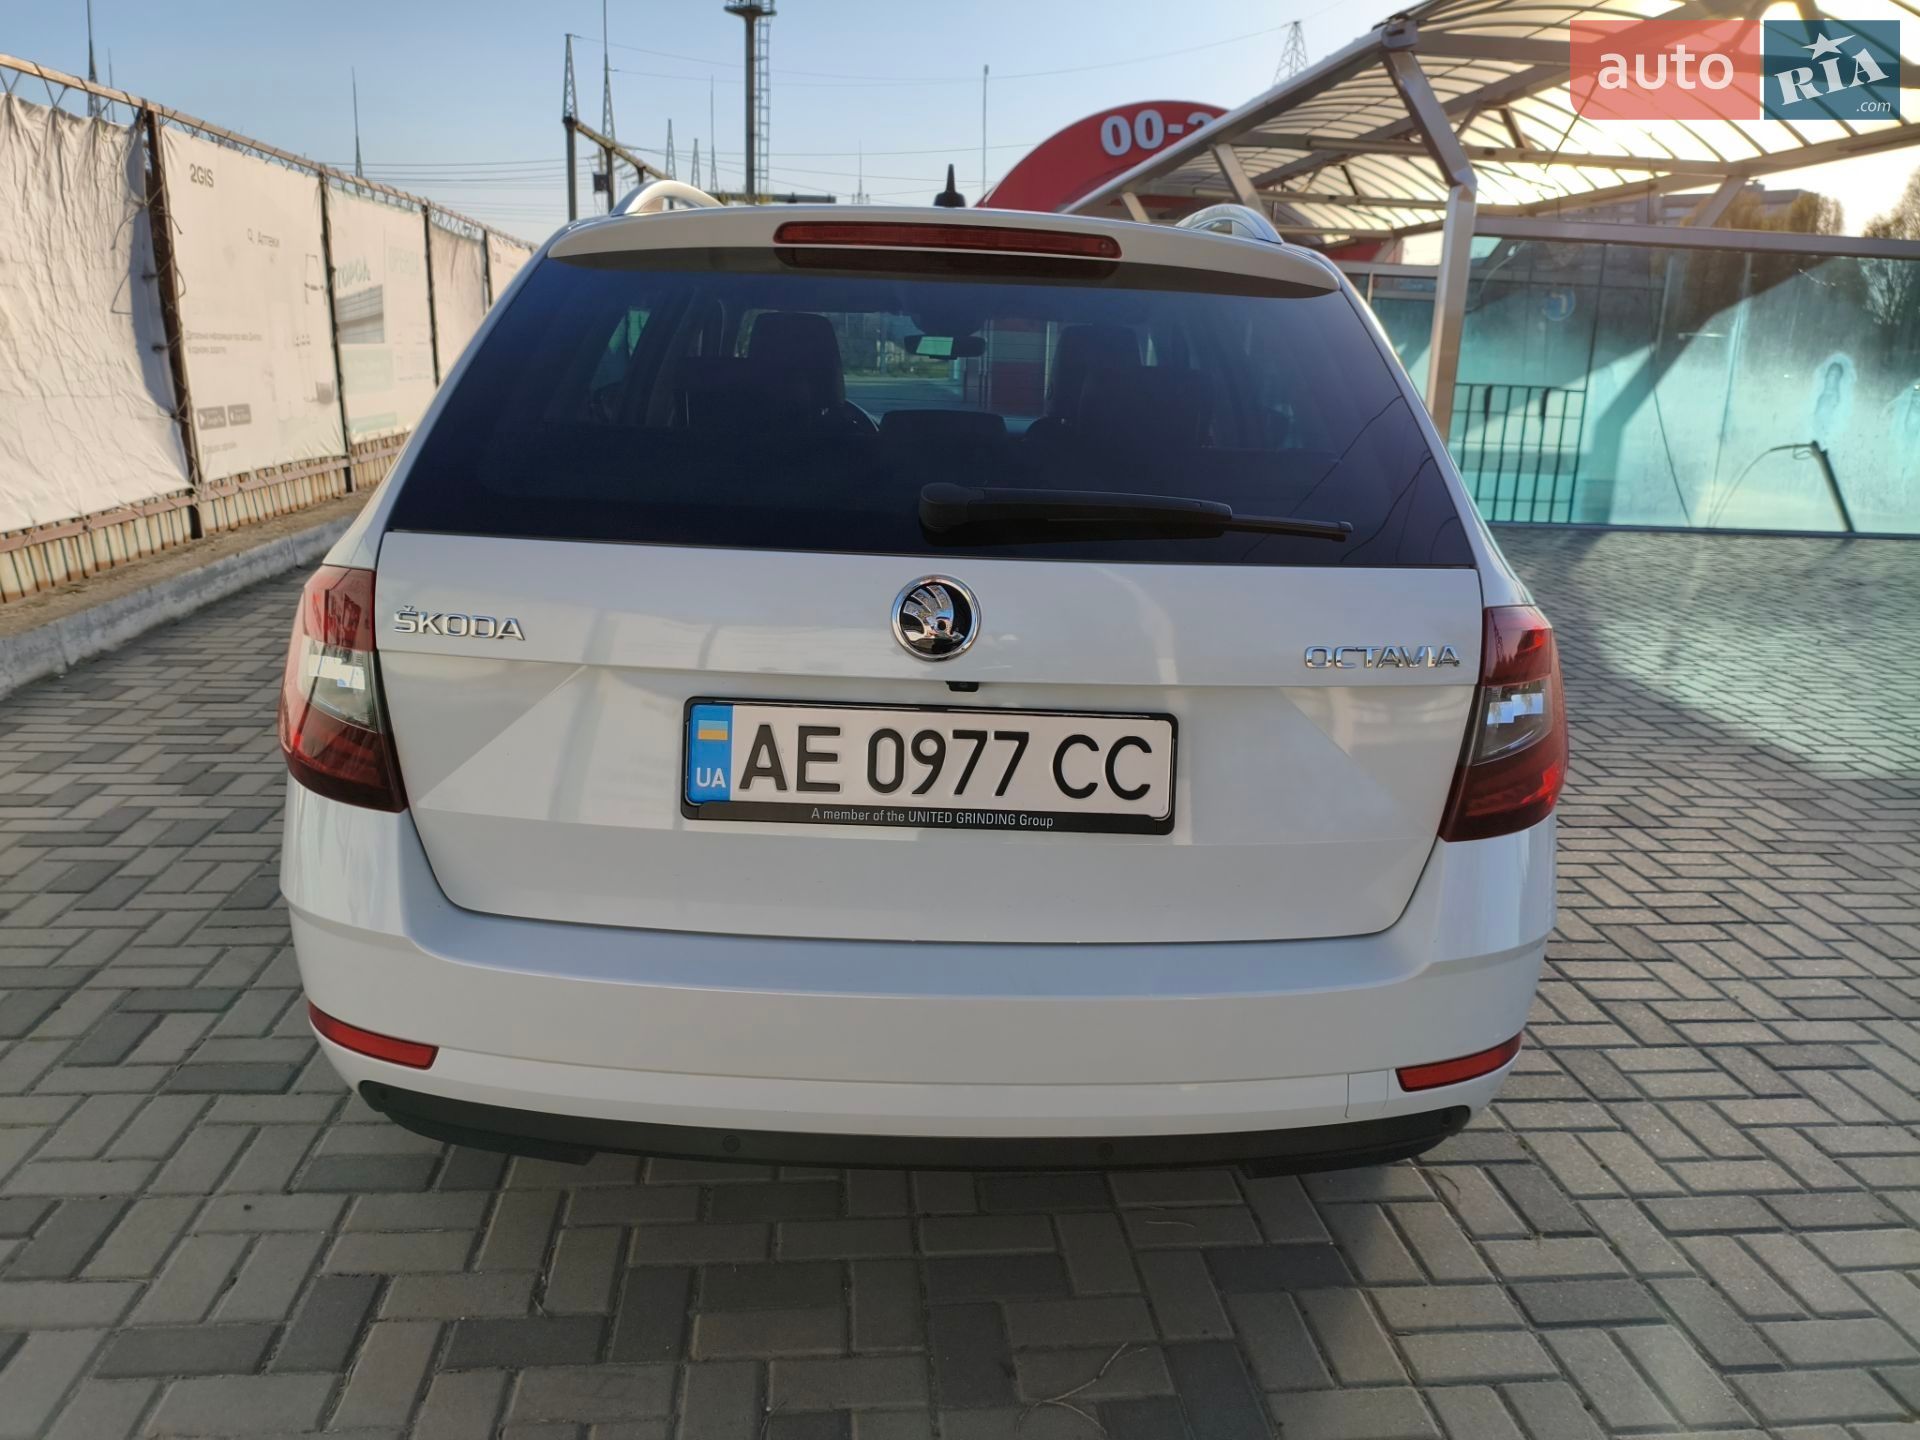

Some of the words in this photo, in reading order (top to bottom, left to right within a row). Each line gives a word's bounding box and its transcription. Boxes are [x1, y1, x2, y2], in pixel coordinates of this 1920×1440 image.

[190, 163, 214, 188] 2GIS
[393, 604, 526, 641] ŠKODA
[1304, 644, 1461, 669] OCTAVIA
[738, 723, 842, 793] AE
[866, 727, 1031, 798] 0977
[1051, 733, 1154, 801] CC
[695, 766, 727, 789] UA
[811, 807, 821, 819] A
[823, 808, 871, 821] member
[873, 809, 885, 821] of
[887, 810, 905, 822] the
[908, 810, 953, 824] UNITED
[956, 812, 1016, 826] GRINDING
[1019, 814, 1054, 829] Group
